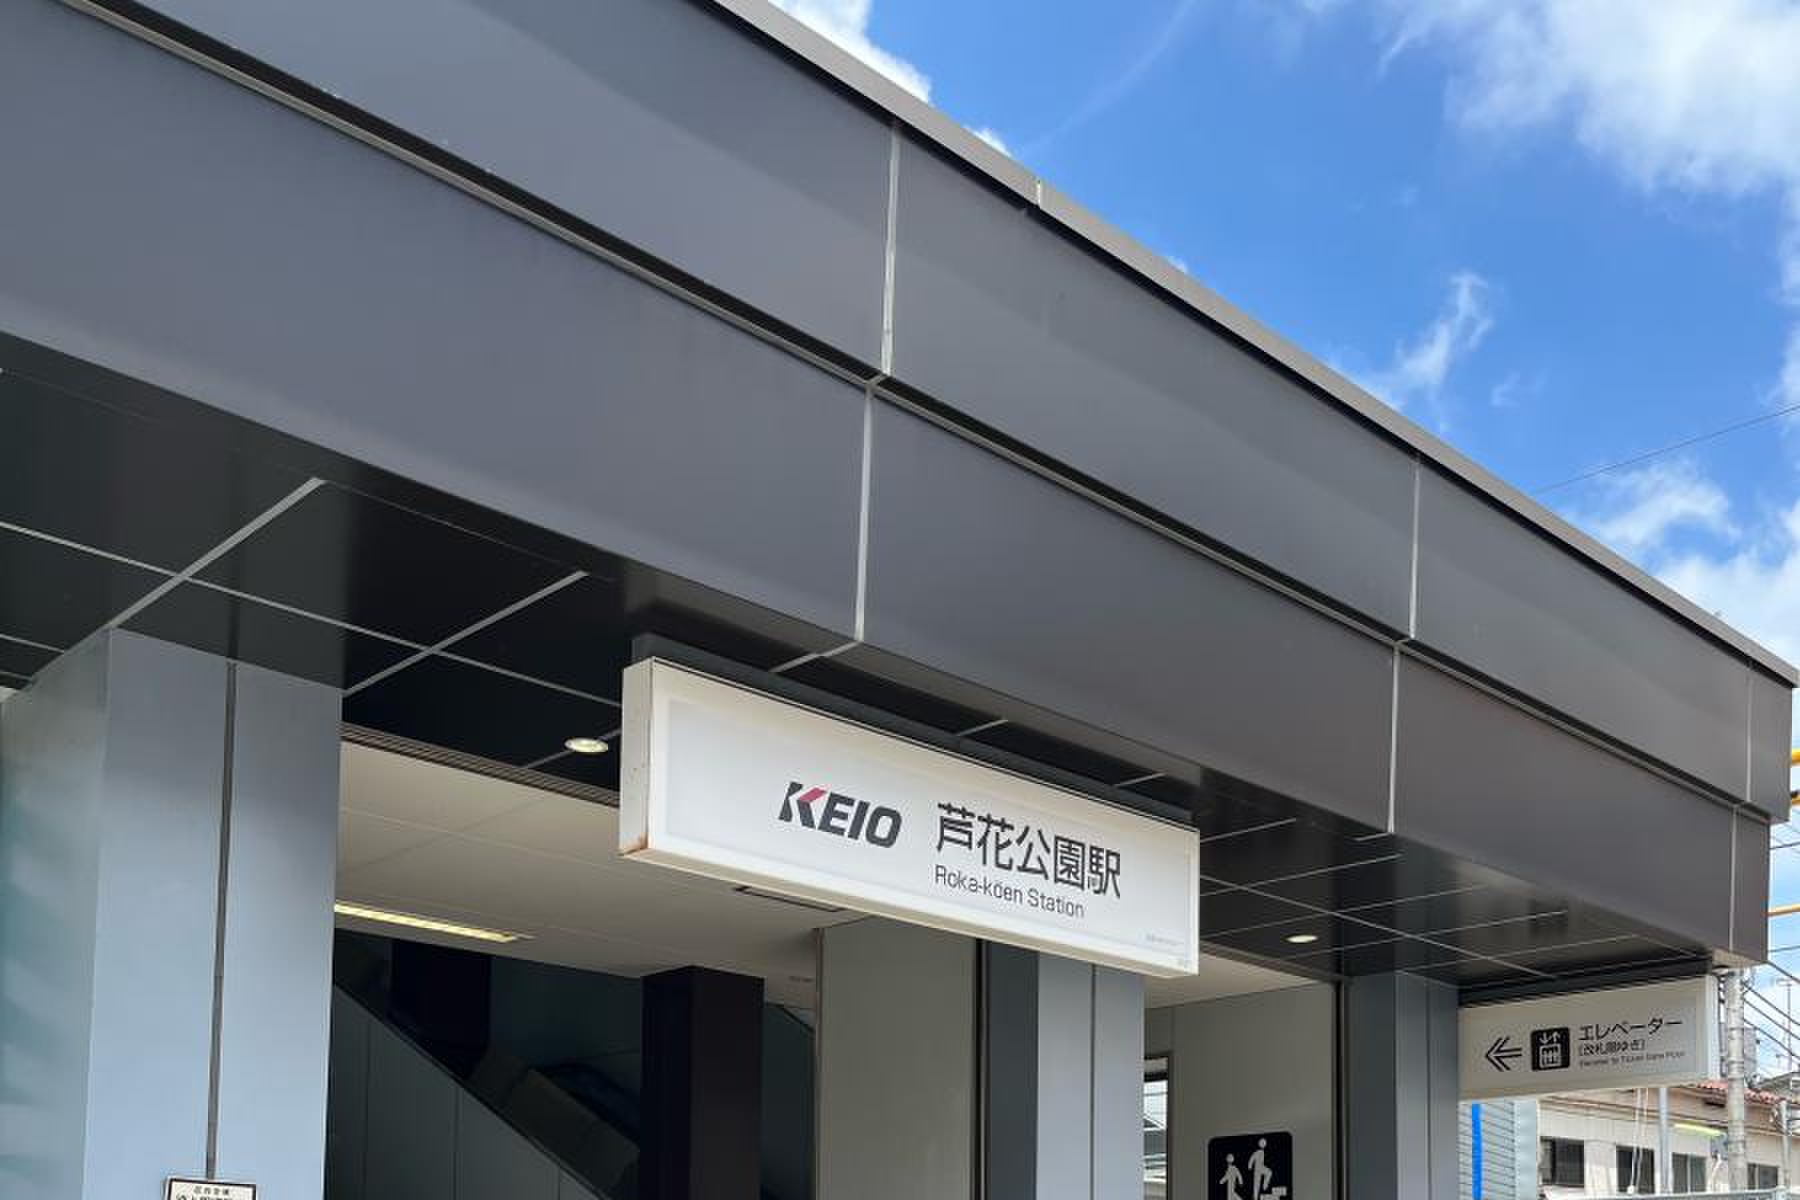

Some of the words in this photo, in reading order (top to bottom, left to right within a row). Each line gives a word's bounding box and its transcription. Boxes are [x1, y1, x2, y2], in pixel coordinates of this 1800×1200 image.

[778, 780, 902, 849] KEIO
[936, 802, 1121, 900] 芦花公園駅
[1026, 888, 1085, 918] Station
[1578, 1017, 1683, 1041] エレベーター
